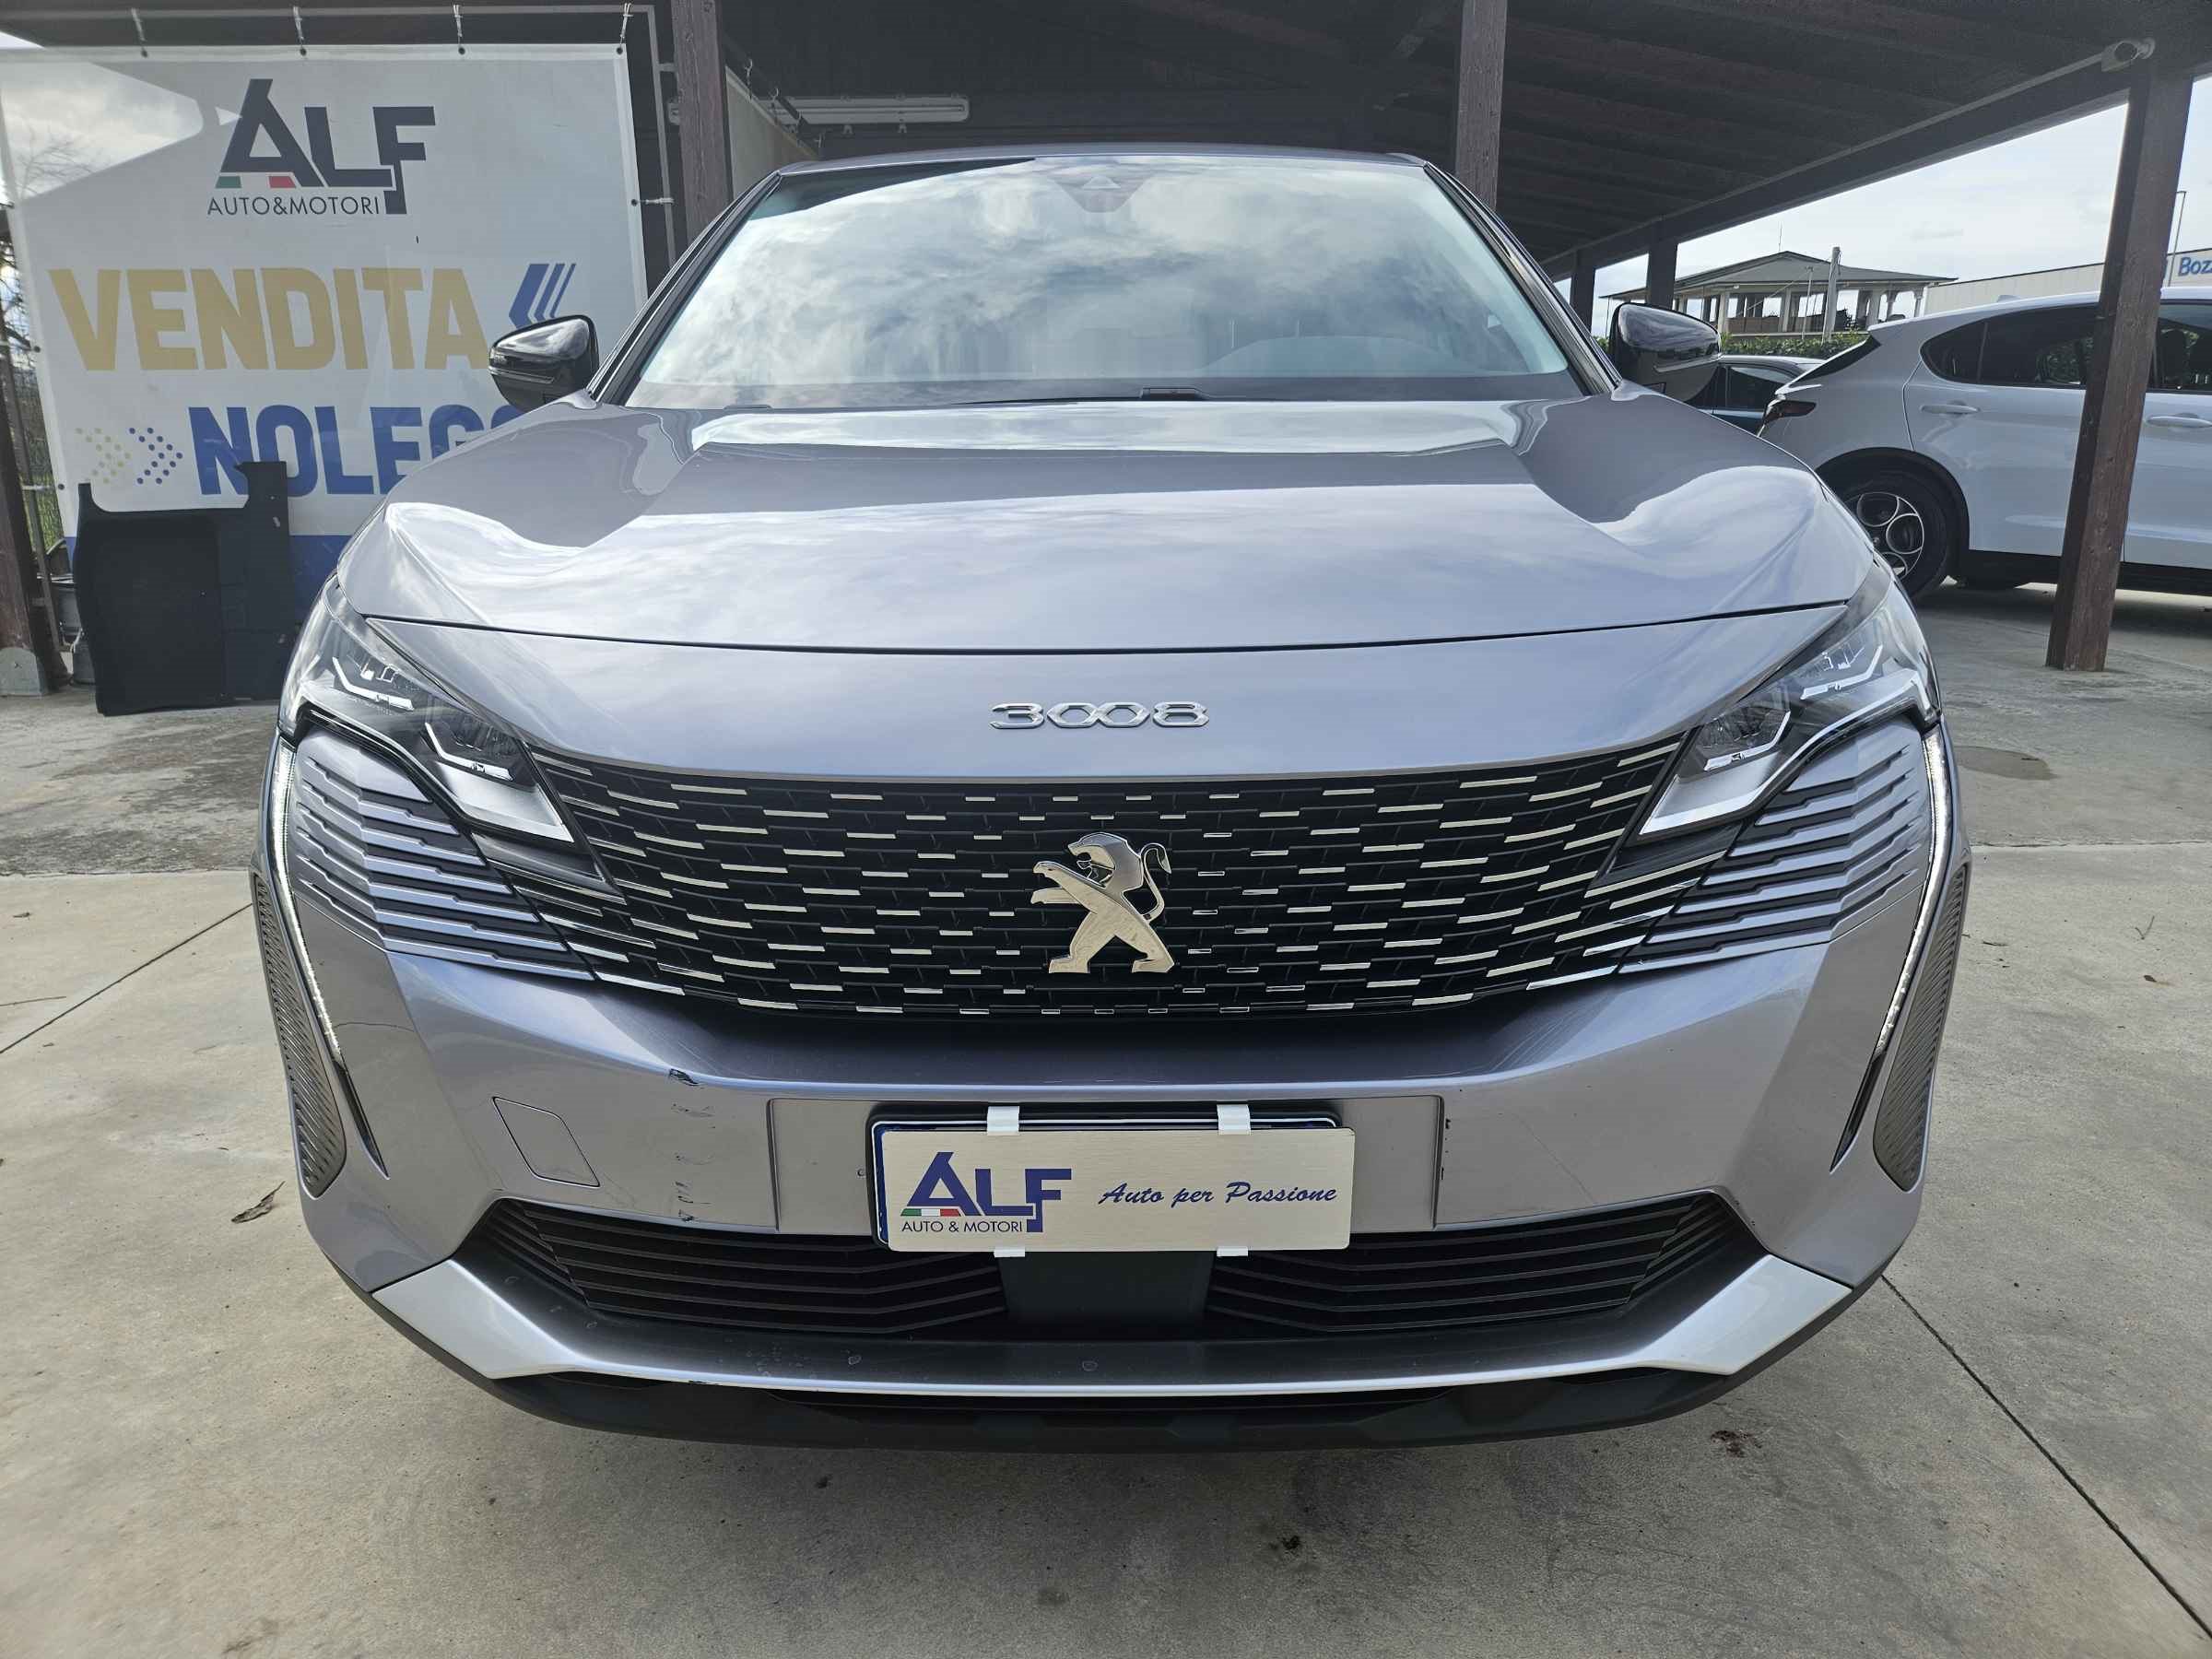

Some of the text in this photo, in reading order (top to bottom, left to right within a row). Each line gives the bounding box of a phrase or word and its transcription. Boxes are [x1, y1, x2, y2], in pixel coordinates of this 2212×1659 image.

[219, 78, 436, 215] ALF
[206, 195, 380, 216] AUTO&MOTORI
[48, 267, 491, 371] VENDITA
[989, 701, 1209, 729] 3008
[906, 1151, 1072, 1233] ALF
[1098, 1181, 1337, 1208] Auto per Passione
[901, 1220, 1022, 1233] AUTO & MOTORI
